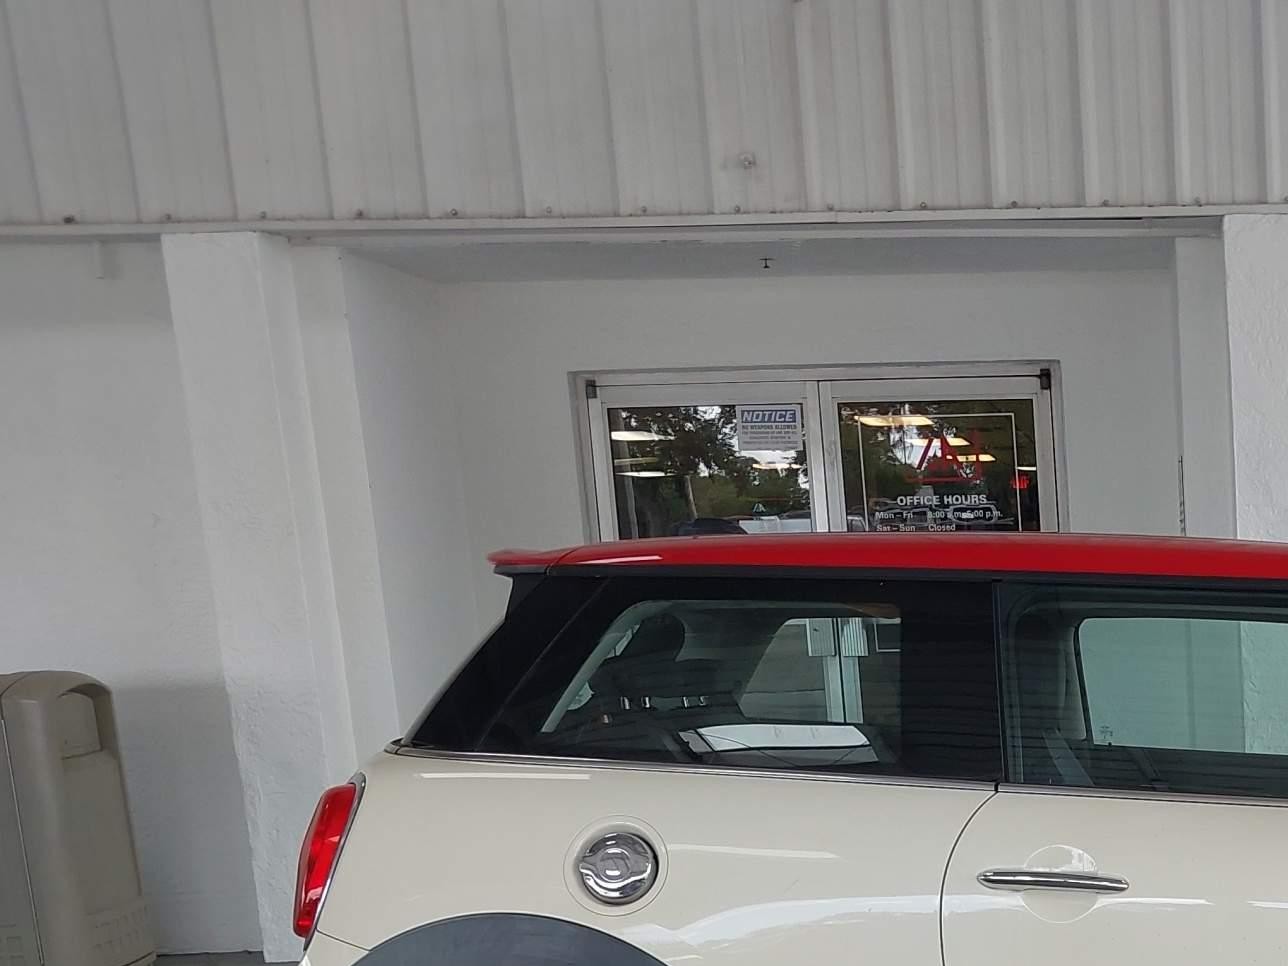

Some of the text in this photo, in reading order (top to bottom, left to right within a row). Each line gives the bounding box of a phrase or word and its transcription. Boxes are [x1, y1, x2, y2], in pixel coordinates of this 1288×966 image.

[742, 410, 795, 422] NOTICE
[897, 494, 987, 506] OFFICE HOURS
[875, 511, 894, 519] Mon
[903, 511, 913, 519] Fri
[899, 523, 916, 531] Sun
[928, 523, 956, 531] Closed
